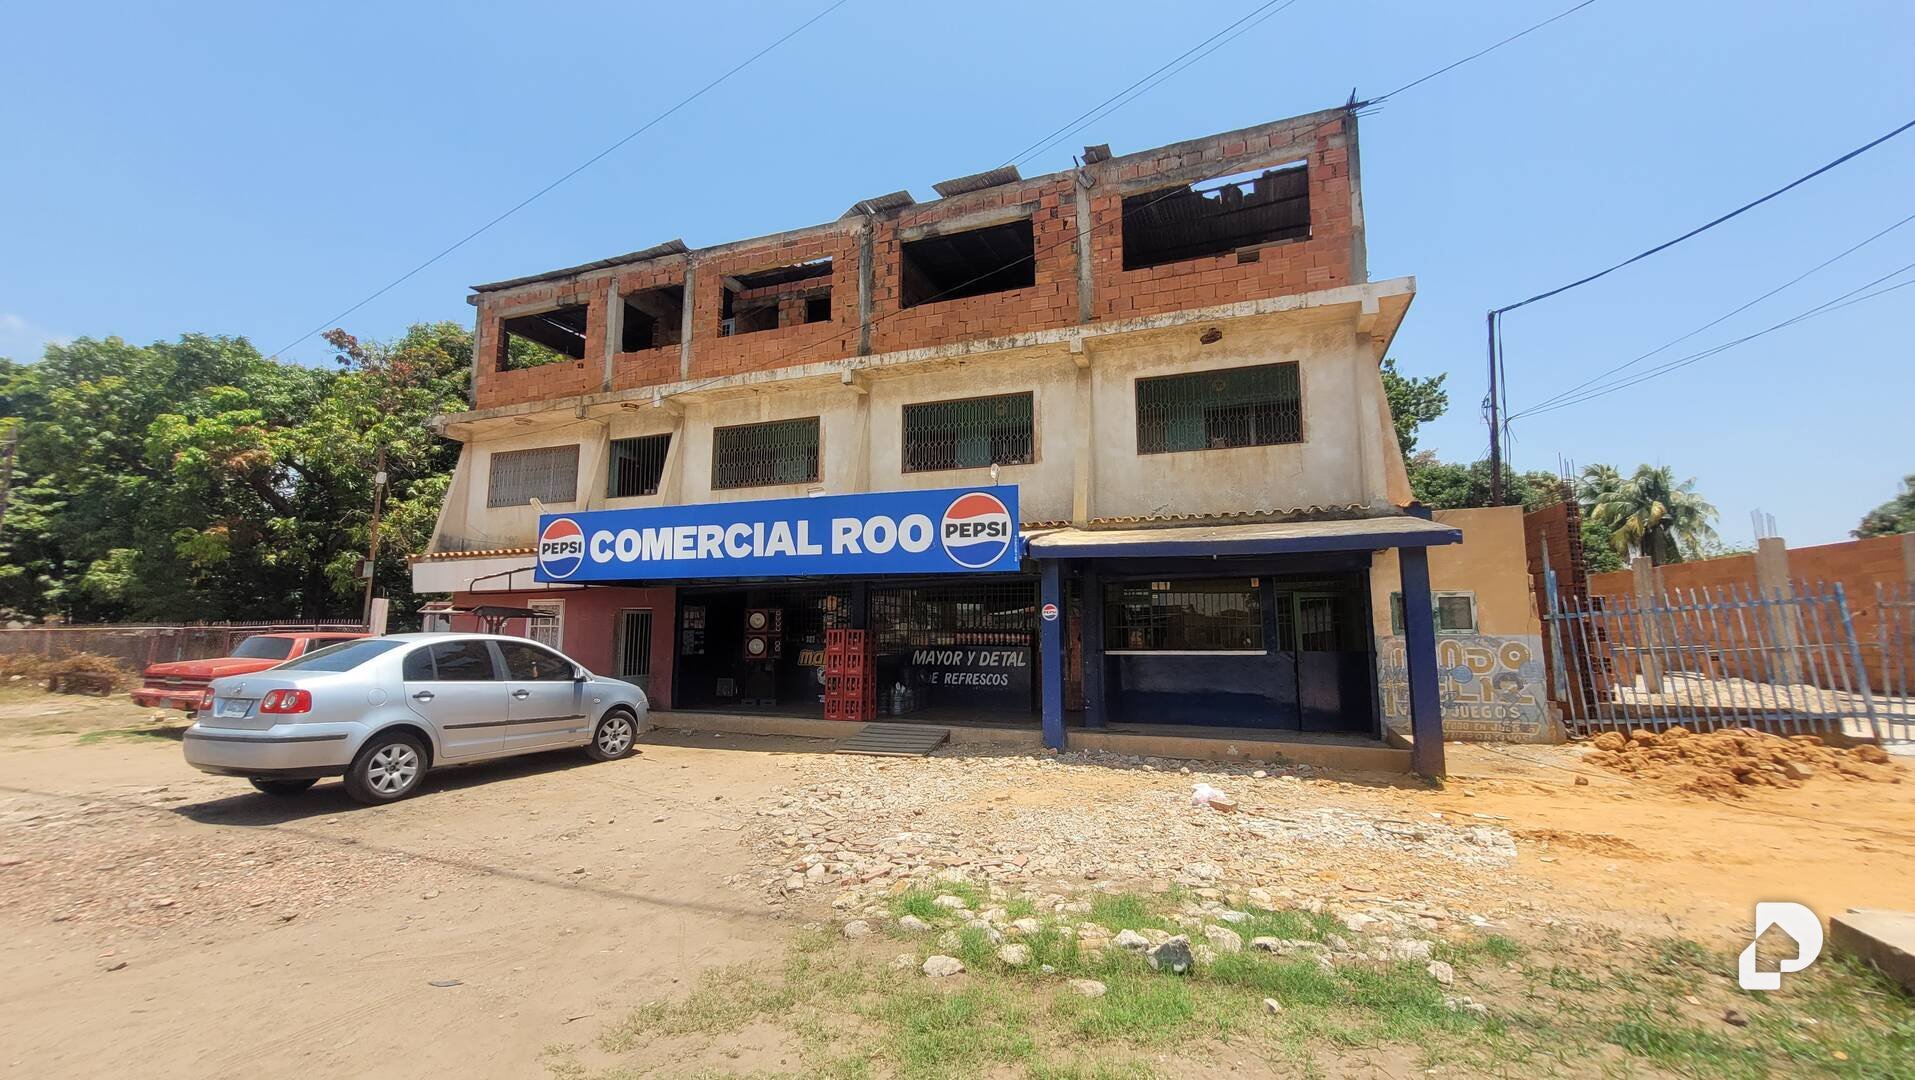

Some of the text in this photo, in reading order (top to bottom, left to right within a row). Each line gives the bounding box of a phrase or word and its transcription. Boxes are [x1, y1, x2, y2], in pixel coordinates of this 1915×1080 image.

[945, 520, 1008, 539] PEPSI
[589, 513, 935, 564] COMERCIAL ROO
[541, 541, 583, 556] PEPSI
[911, 649, 1027, 668] MAYOR Y DETAL
[944, 672, 1009, 686] REFRESCOS
[1451, 704, 1521, 719] JUEGOS
